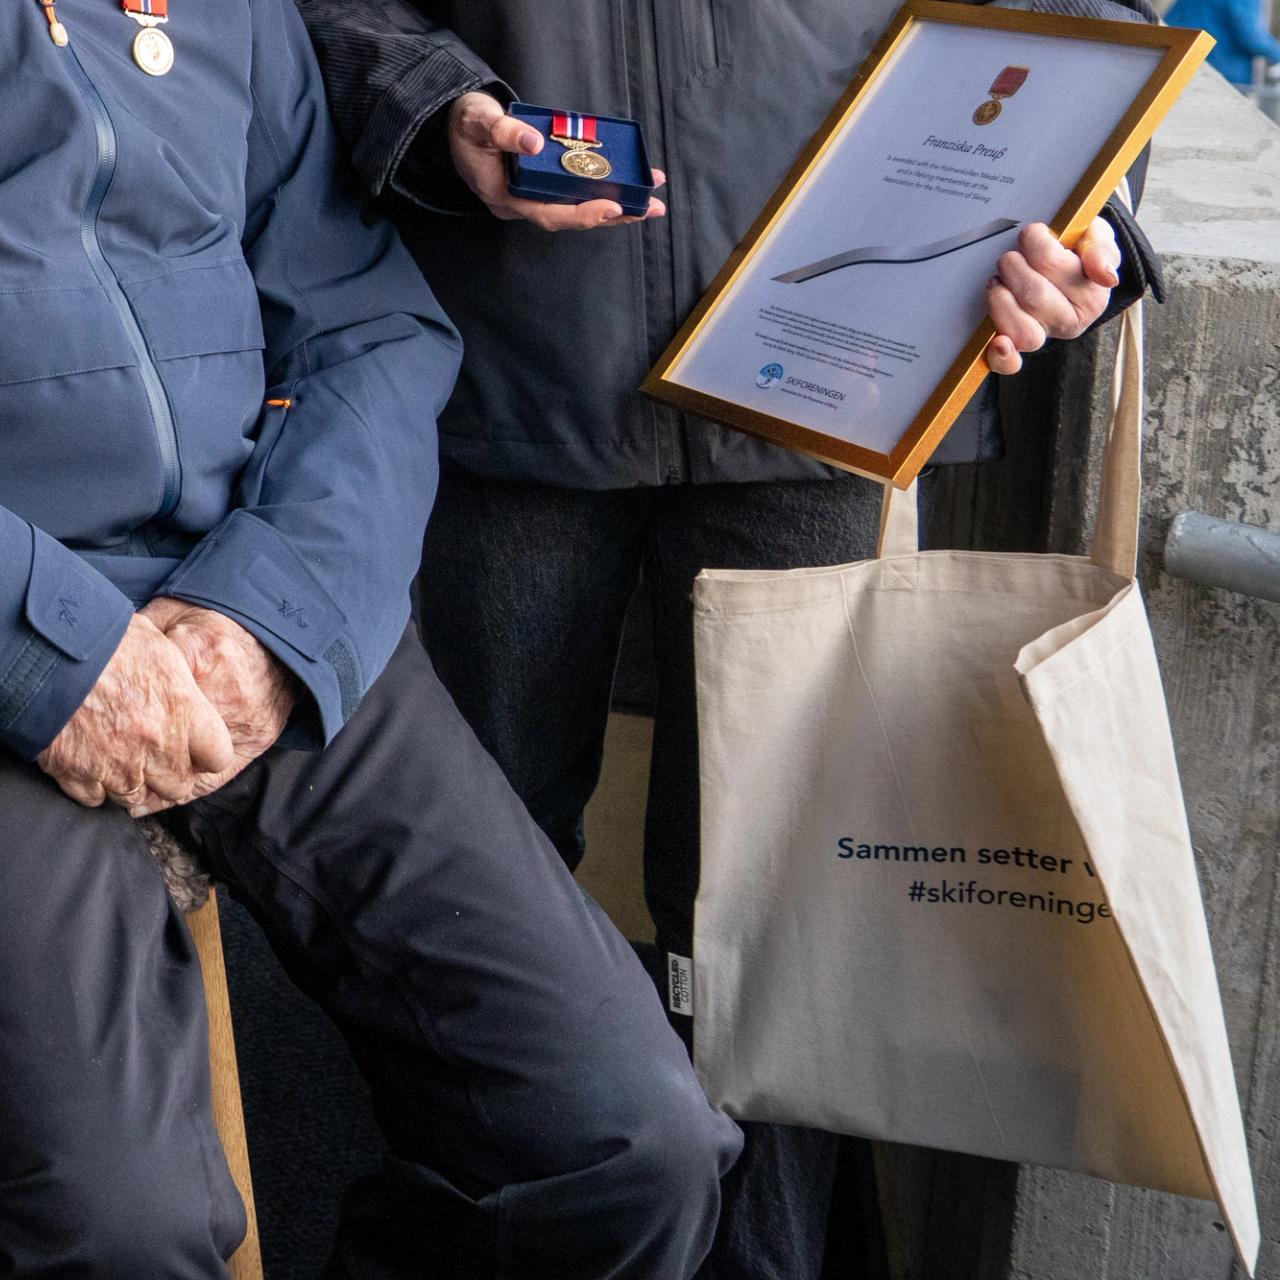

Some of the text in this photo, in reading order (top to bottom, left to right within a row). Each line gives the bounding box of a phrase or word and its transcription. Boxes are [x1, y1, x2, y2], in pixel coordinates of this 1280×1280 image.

[923, 135, 973, 153] Franziska
[785, 376, 847, 402] SKIFORENINGEN
[837, 837, 966, 863] Sammen
[977, 845, 1072, 874] setter
[908, 880, 1111, 925] #skiforeninge
[679, 968, 689, 1004] COTTON
